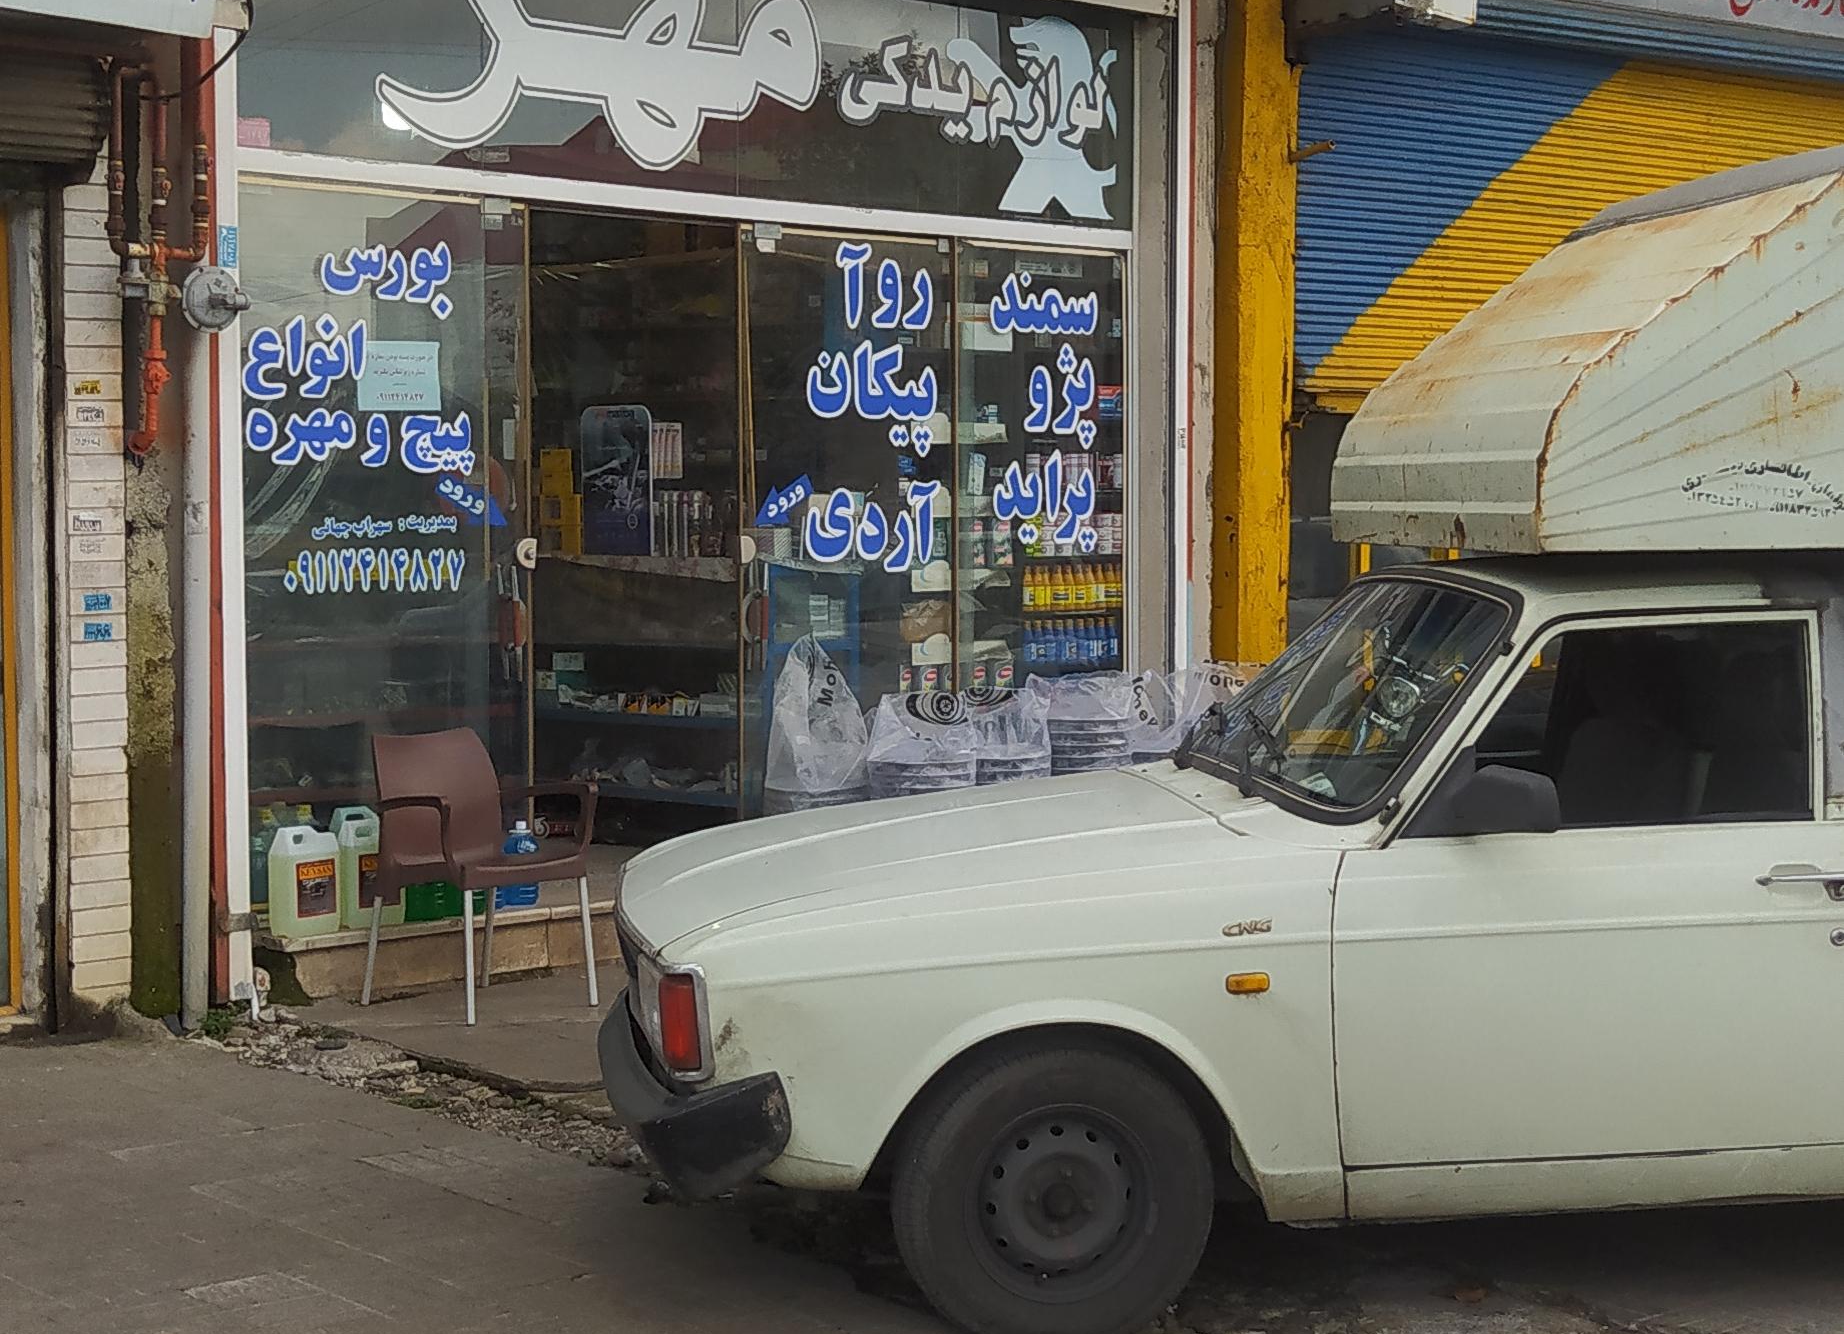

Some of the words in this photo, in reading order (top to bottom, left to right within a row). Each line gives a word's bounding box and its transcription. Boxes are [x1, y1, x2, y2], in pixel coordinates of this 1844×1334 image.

[836, 34, 974, 145] یدکی
[986, 55, 1108, 150] لوازم
[321, 241, 454, 320] بورس
[989, 270, 1098, 336] سمند
[242, 312, 368, 400] انواع
[806, 339, 938, 457] پیکان
[1023, 342, 1097, 450] پژو
[245, 407, 357, 466] مهره
[360, 412, 391, 467] و
[400, 410, 476, 476] پیچ
[353, 515, 393, 539] سهراب
[438, 477, 486, 515] ورود
[767, 484, 806, 518] ورود
[805, 478, 941, 574] آردی
[991, 448, 1098, 555] پراید
[311, 517, 353, 542] جهانی
[283, 547, 466, 596] ۰۹۱۱۲۴۱۴۸۲۷
